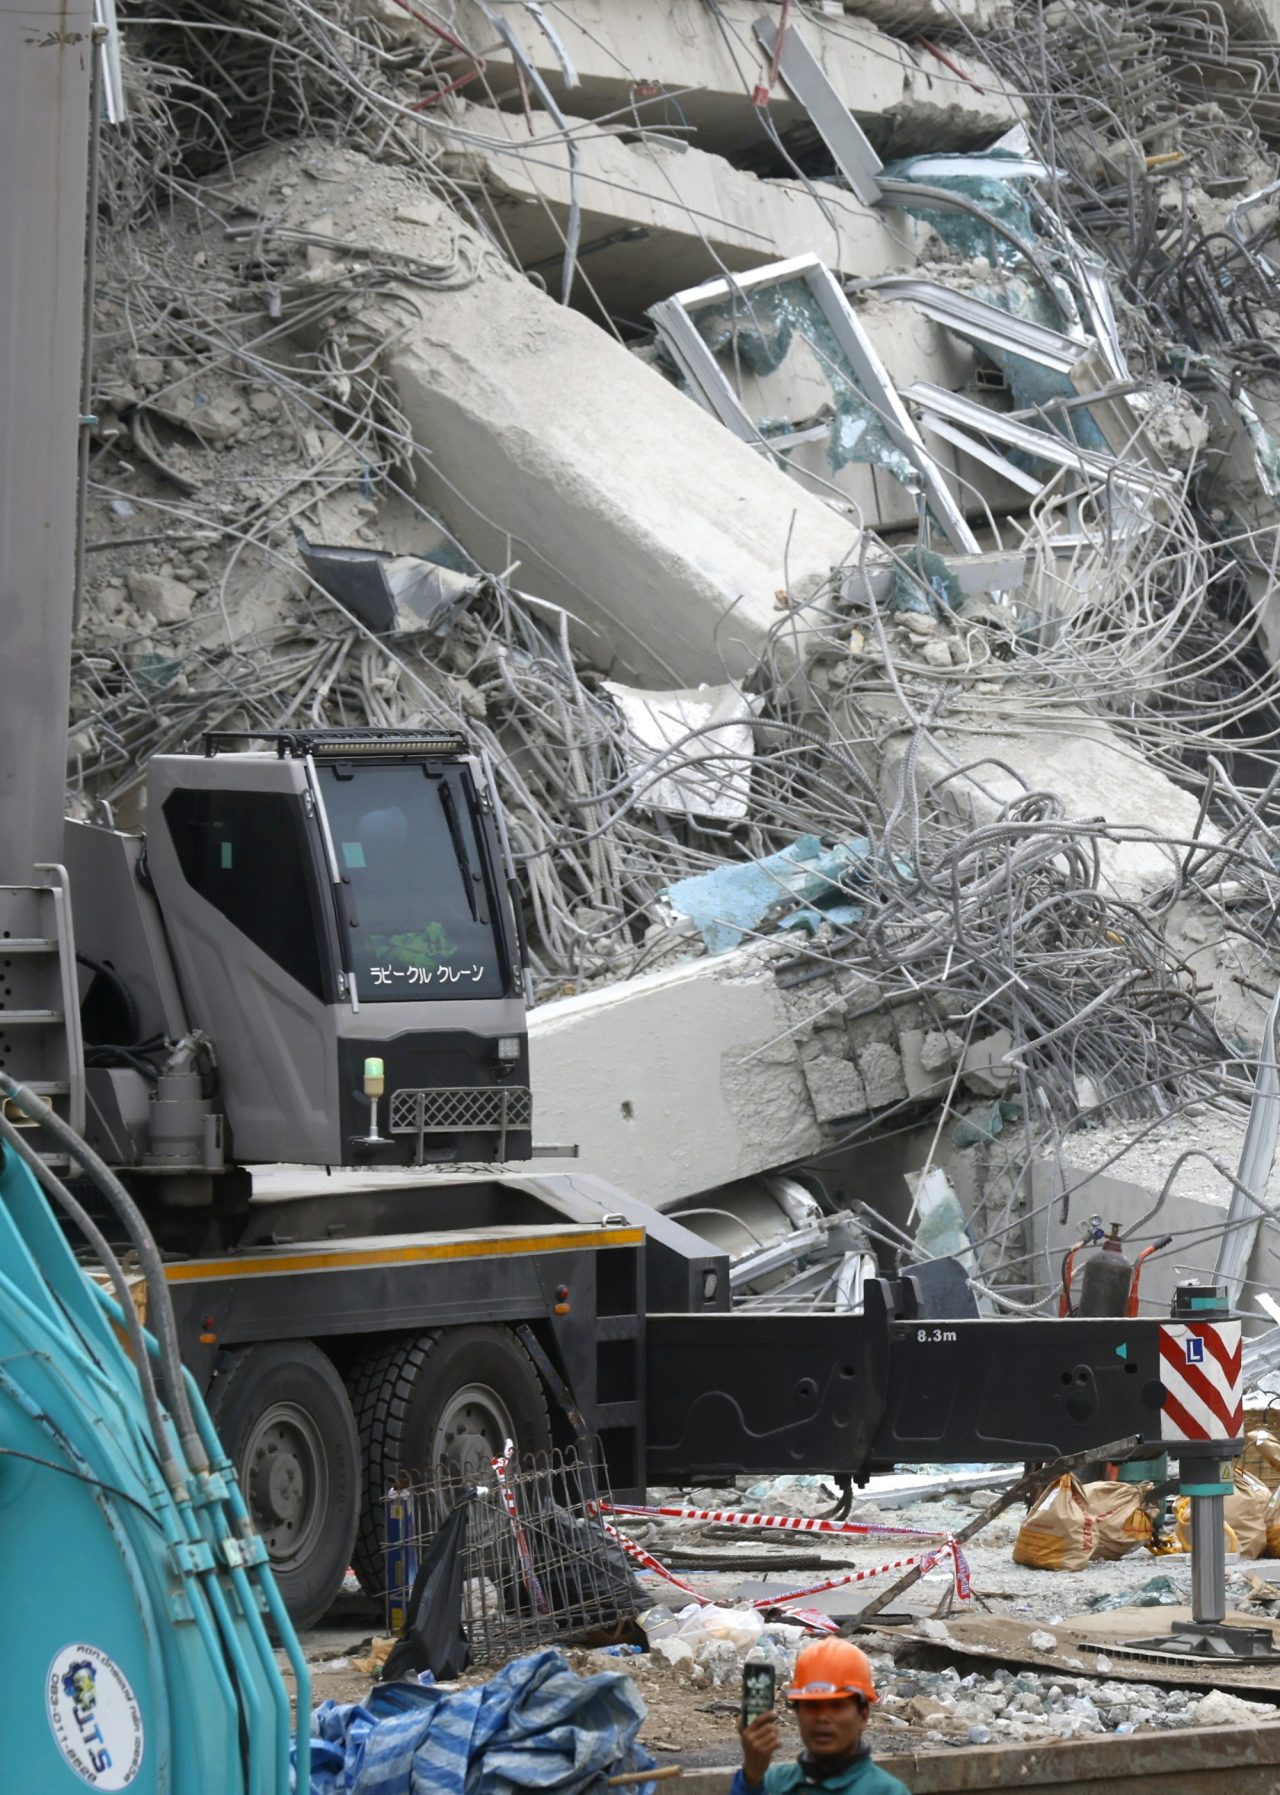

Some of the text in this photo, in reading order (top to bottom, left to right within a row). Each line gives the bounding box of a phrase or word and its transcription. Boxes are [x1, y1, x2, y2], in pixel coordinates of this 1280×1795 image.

[437, 964, 484, 983] クレーン
[917, 1328, 957, 1342] 8.3m
[1189, 1340, 1201, 1361] L
